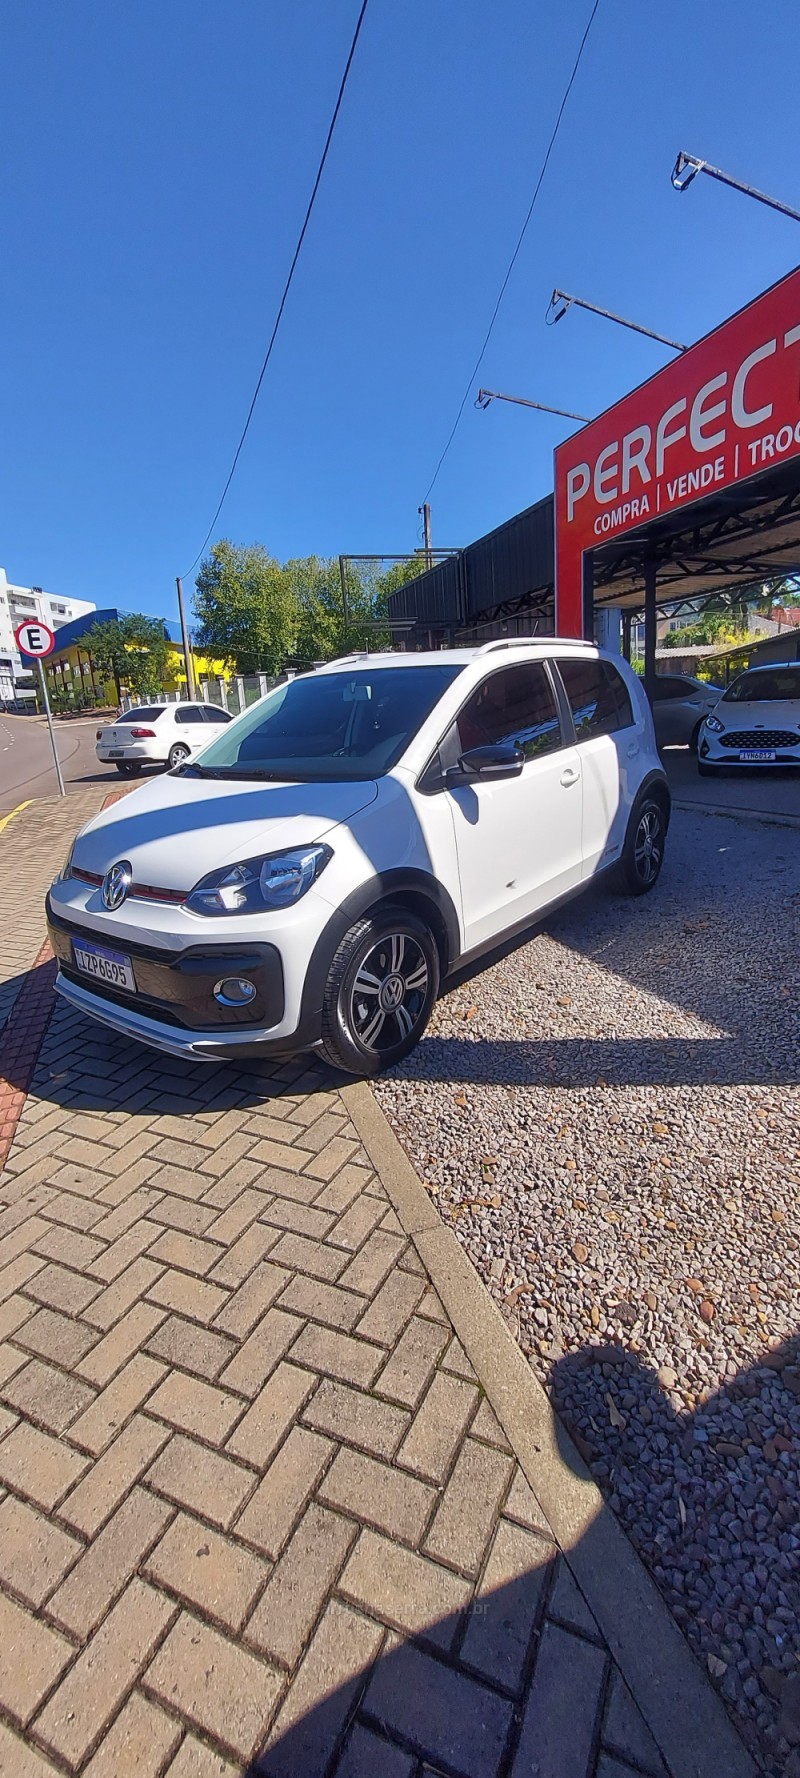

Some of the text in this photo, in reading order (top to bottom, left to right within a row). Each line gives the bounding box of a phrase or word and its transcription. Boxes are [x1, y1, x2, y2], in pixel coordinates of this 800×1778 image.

[594, 495, 650, 535] COMPRA
[667, 456, 725, 502] VENDE
[27, 629, 43, 650] E
[79, 951, 127, 986] IZP6G95
